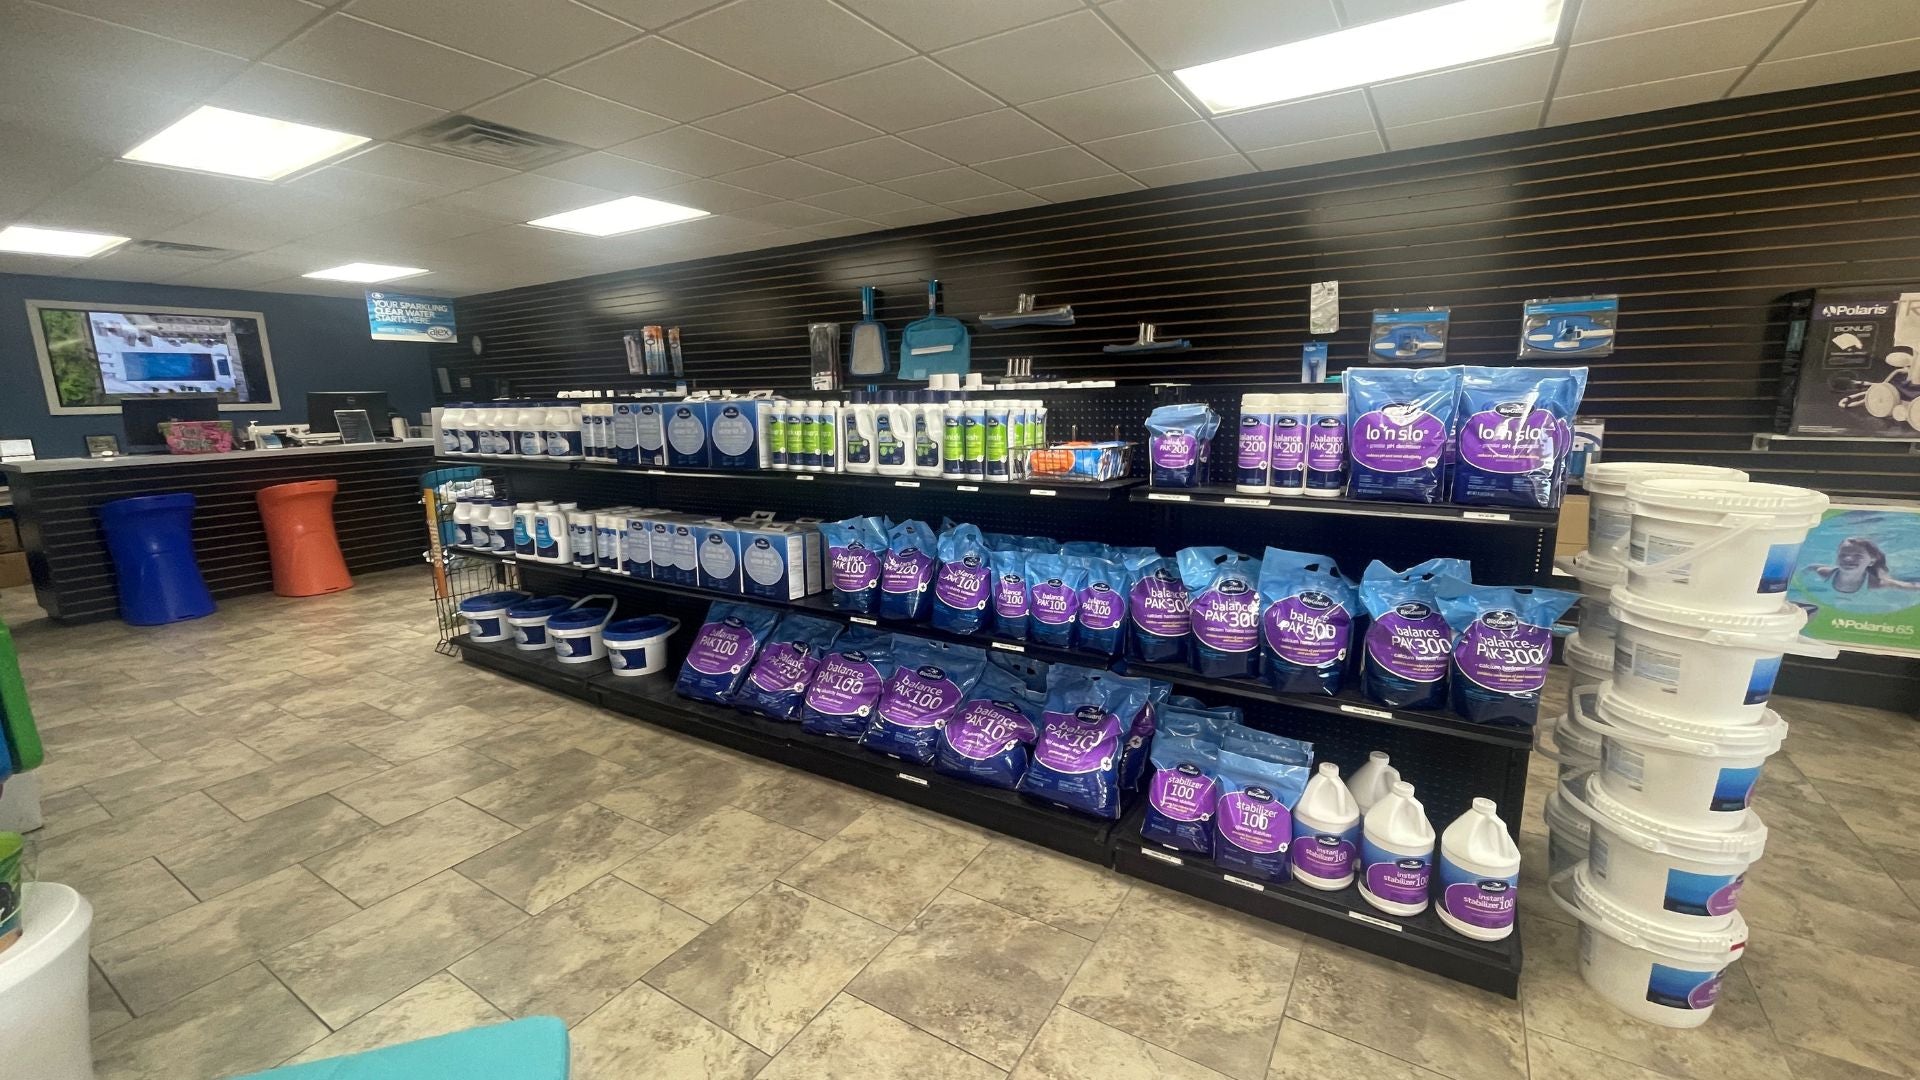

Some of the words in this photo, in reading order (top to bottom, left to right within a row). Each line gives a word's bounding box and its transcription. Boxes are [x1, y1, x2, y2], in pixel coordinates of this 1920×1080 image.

[372, 299, 398, 309] YOUR
[400, 301, 448, 312] SPARKLING
[1836, 304, 1888, 315] Polaris
[374, 307, 403, 317] CLEAR
[405, 309, 435, 318] WATER
[375, 314, 406, 323] STARTS
[409, 316, 431, 324] HERE
[1366, 423, 1396, 441] lo'n
[1171, 444, 1188, 454] 200
[1245, 441, 1266, 452] 200
[1283, 442, 1304, 454] 200
[1310, 441, 1325, 450] PAK
[845, 561, 867, 573] 100
[957, 577, 979, 591] 100
[1006, 595, 1023, 604] 100
[1151, 587, 1187, 599] balance
[1050, 601, 1067, 610] 100
[1144, 598, 1166, 609] PAK
[1095, 605, 1111, 616] 100
[1204, 610, 1229, 623] PAK
[1281, 620, 1305, 636] PAK
[1304, 624, 1336, 641] 300
[1394, 625, 1440, 638] balance
[1845, 619, 1894, 633] Polaris
[1895, 624, 1914, 635] 65
[1391, 636, 1415, 649] PAK
[1414, 638, 1452, 655] 300
[1480, 633, 1531, 648] balance
[713, 639, 739, 656] 100
[1476, 643, 1503, 660] PAK
[1502, 649, 1545, 665] 300
[827, 661, 864, 679] balance
[817, 671, 835, 684] PAK
[833, 677, 864, 694] 100
[902, 675, 943, 695] balance
[894, 681, 911, 698] PAK
[911, 689, 943, 710] 100
[965, 713, 985, 727] PAK
[974, 705, 1018, 731] balance
[1046, 724, 1069, 741] PAK
[1168, 777, 1204, 789] stabilizer
[1170, 784, 1195, 800] 100
[1235, 801, 1278, 818] stabilizer
[1241, 811, 1269, 830] 100
[1305, 848, 1334, 861] stabilizer
[1317, 846, 1339, 855] instant
[1383, 874, 1416, 886] stabilizer
[1397, 872, 1420, 880] instant
[1463, 896, 1499, 908] stabilizer
[1499, 898, 1513, 910] 100
[1478, 893, 1505, 902] instant
